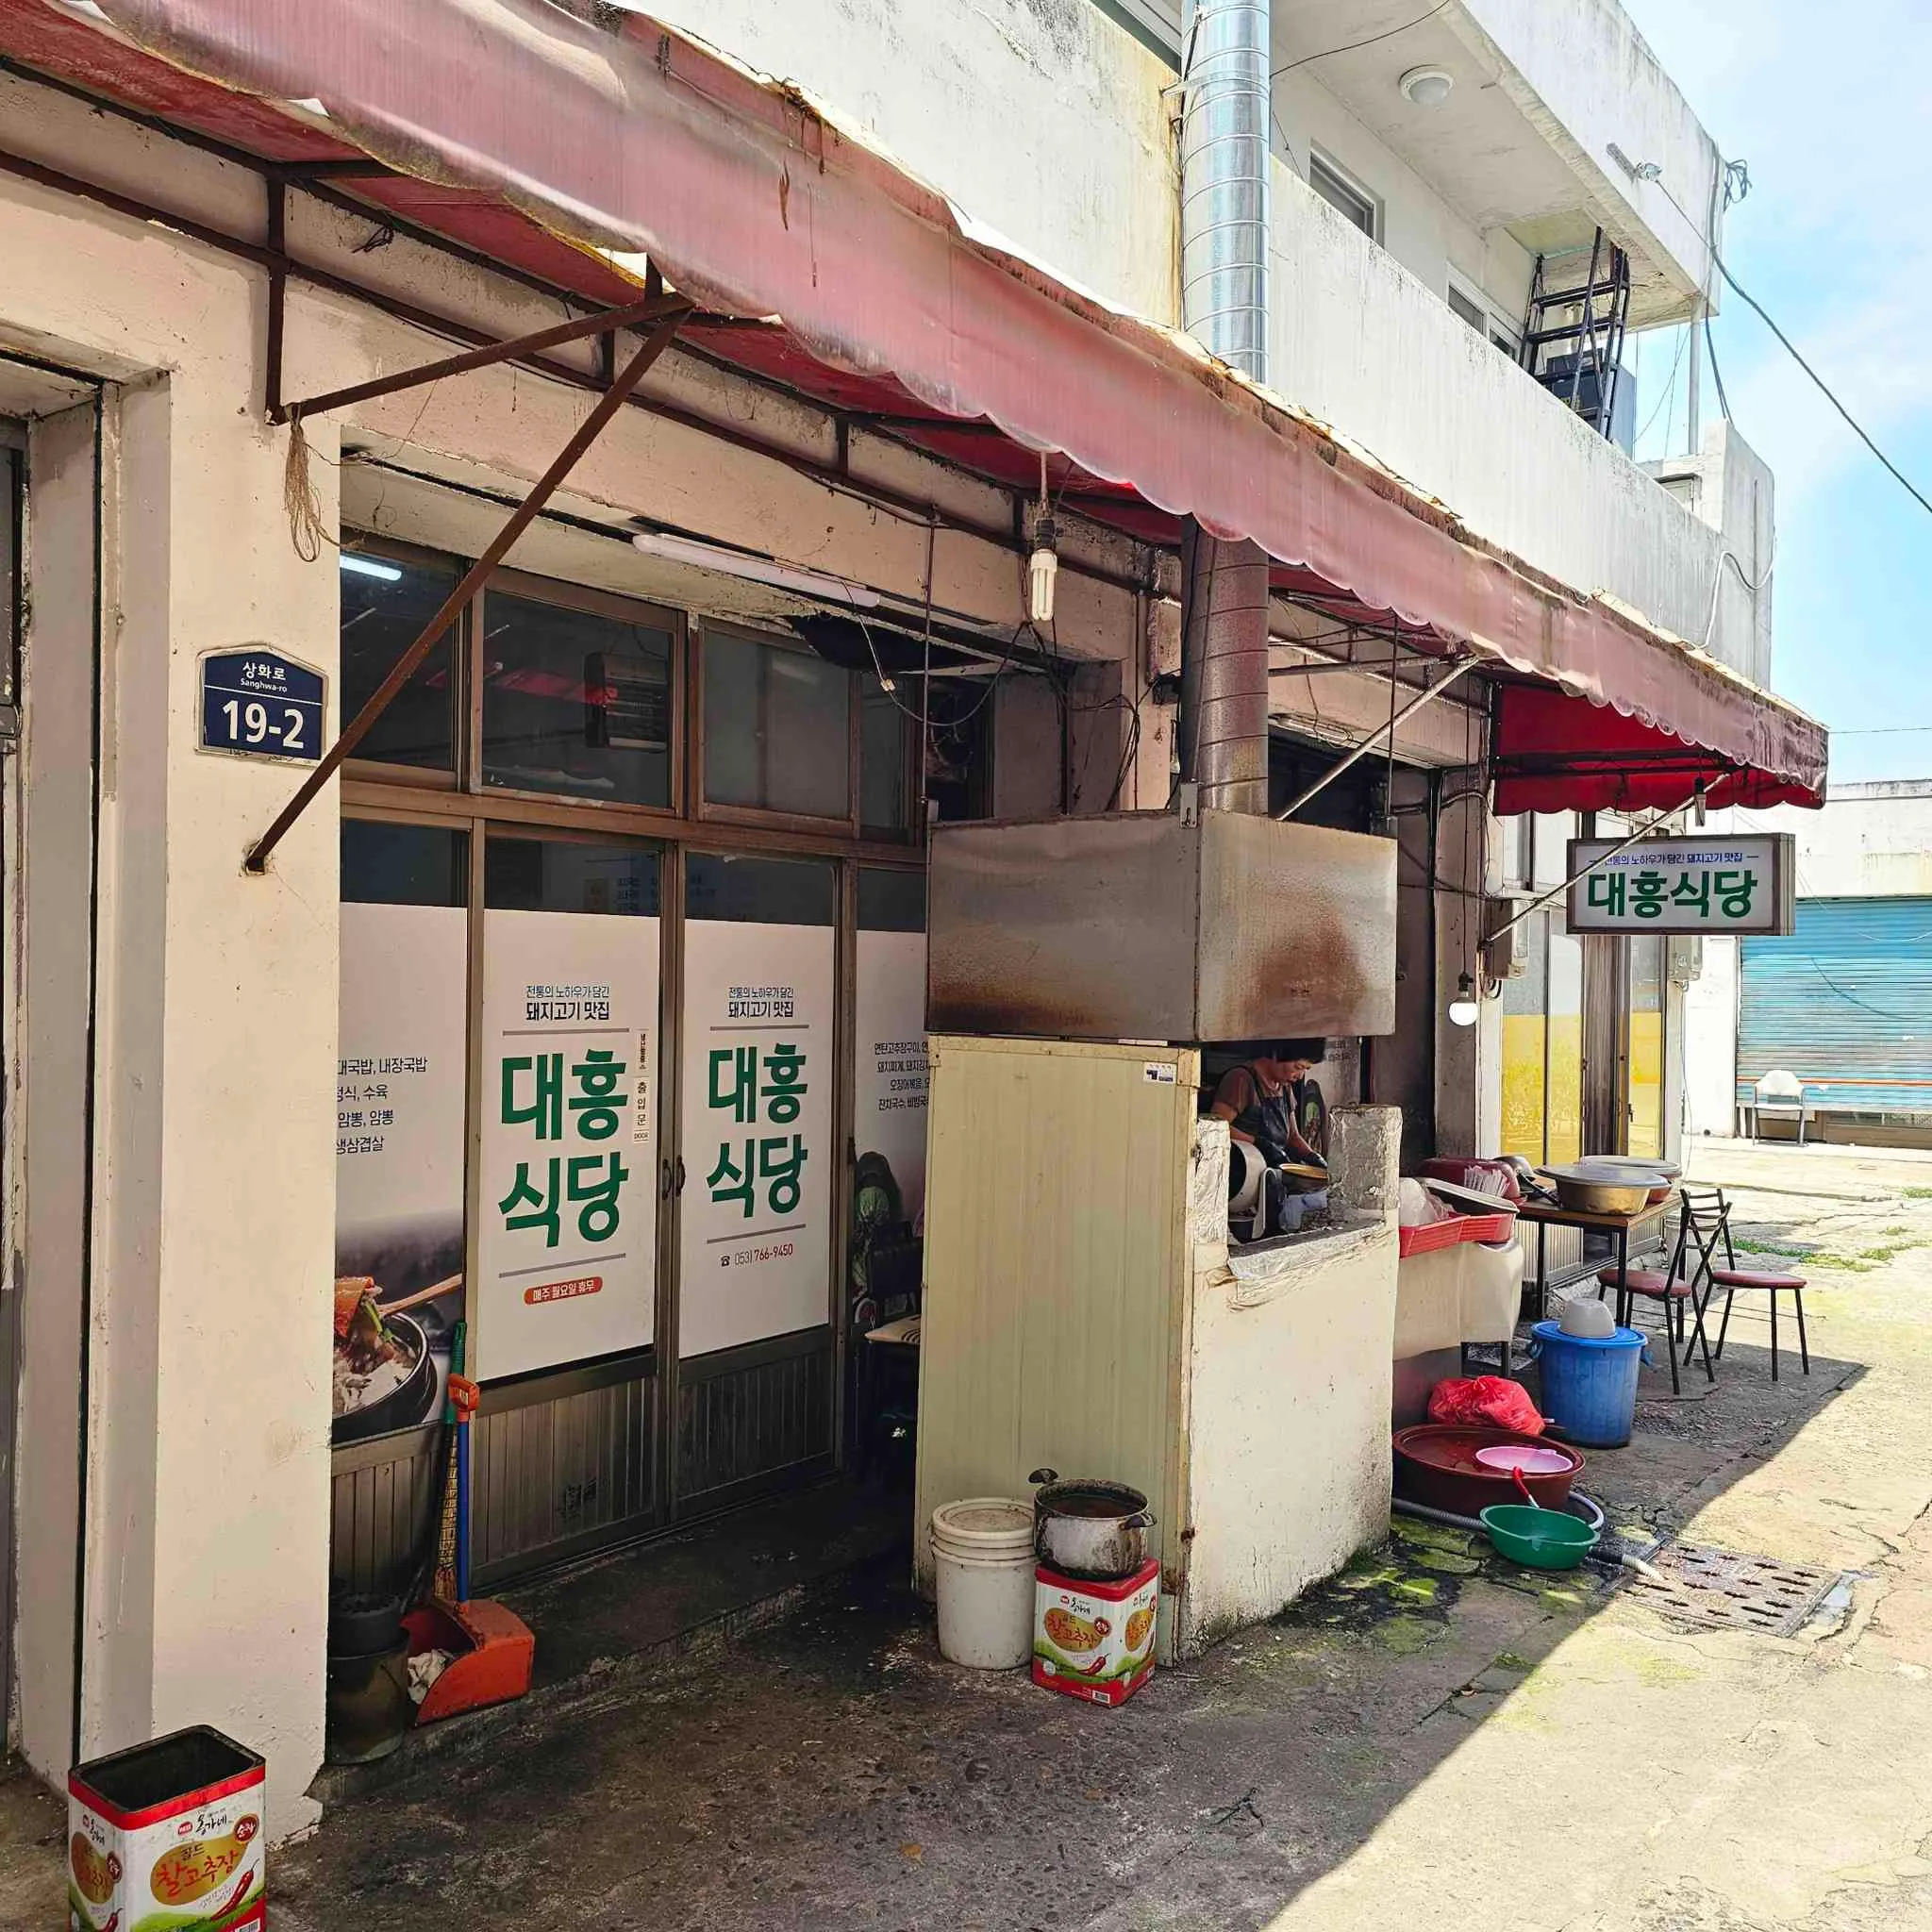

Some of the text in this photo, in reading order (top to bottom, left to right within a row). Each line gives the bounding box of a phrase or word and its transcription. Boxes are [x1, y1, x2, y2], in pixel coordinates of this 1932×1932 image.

[242, 661, 287, 680] 상화로
[241, 678, 288, 692] Sanghwa-ro
[223, 700, 304, 749] 19-2
[1631, 854, 1665, 865] 노하우가
[1687, 853, 1723, 863] 돼지고기
[1724, 852, 1743, 863] 맛집
[1588, 870, 1758, 919] 대흥식당
[526, 985, 609, 999] 전통의 노하우가 담긴
[526, 1002, 609, 1021] 돼지고기 맛집
[728, 1001, 794, 1018] 돼지고기 맛집
[379, 1057, 428, 1074] 내장국밥
[362, 1084, 389, 1101] 수육
[708, 1042, 808, 1124] 대흥
[501, 1048, 628, 1141] 대흥
[370, 1109, 394, 1126] 암뽕
[707, 1134, 808, 1218] 식당
[498, 1151, 629, 1248] 식당
[754, 1243, 793, 1261] 766-9450
[155, 1848, 239, 1898] 찰고추장
